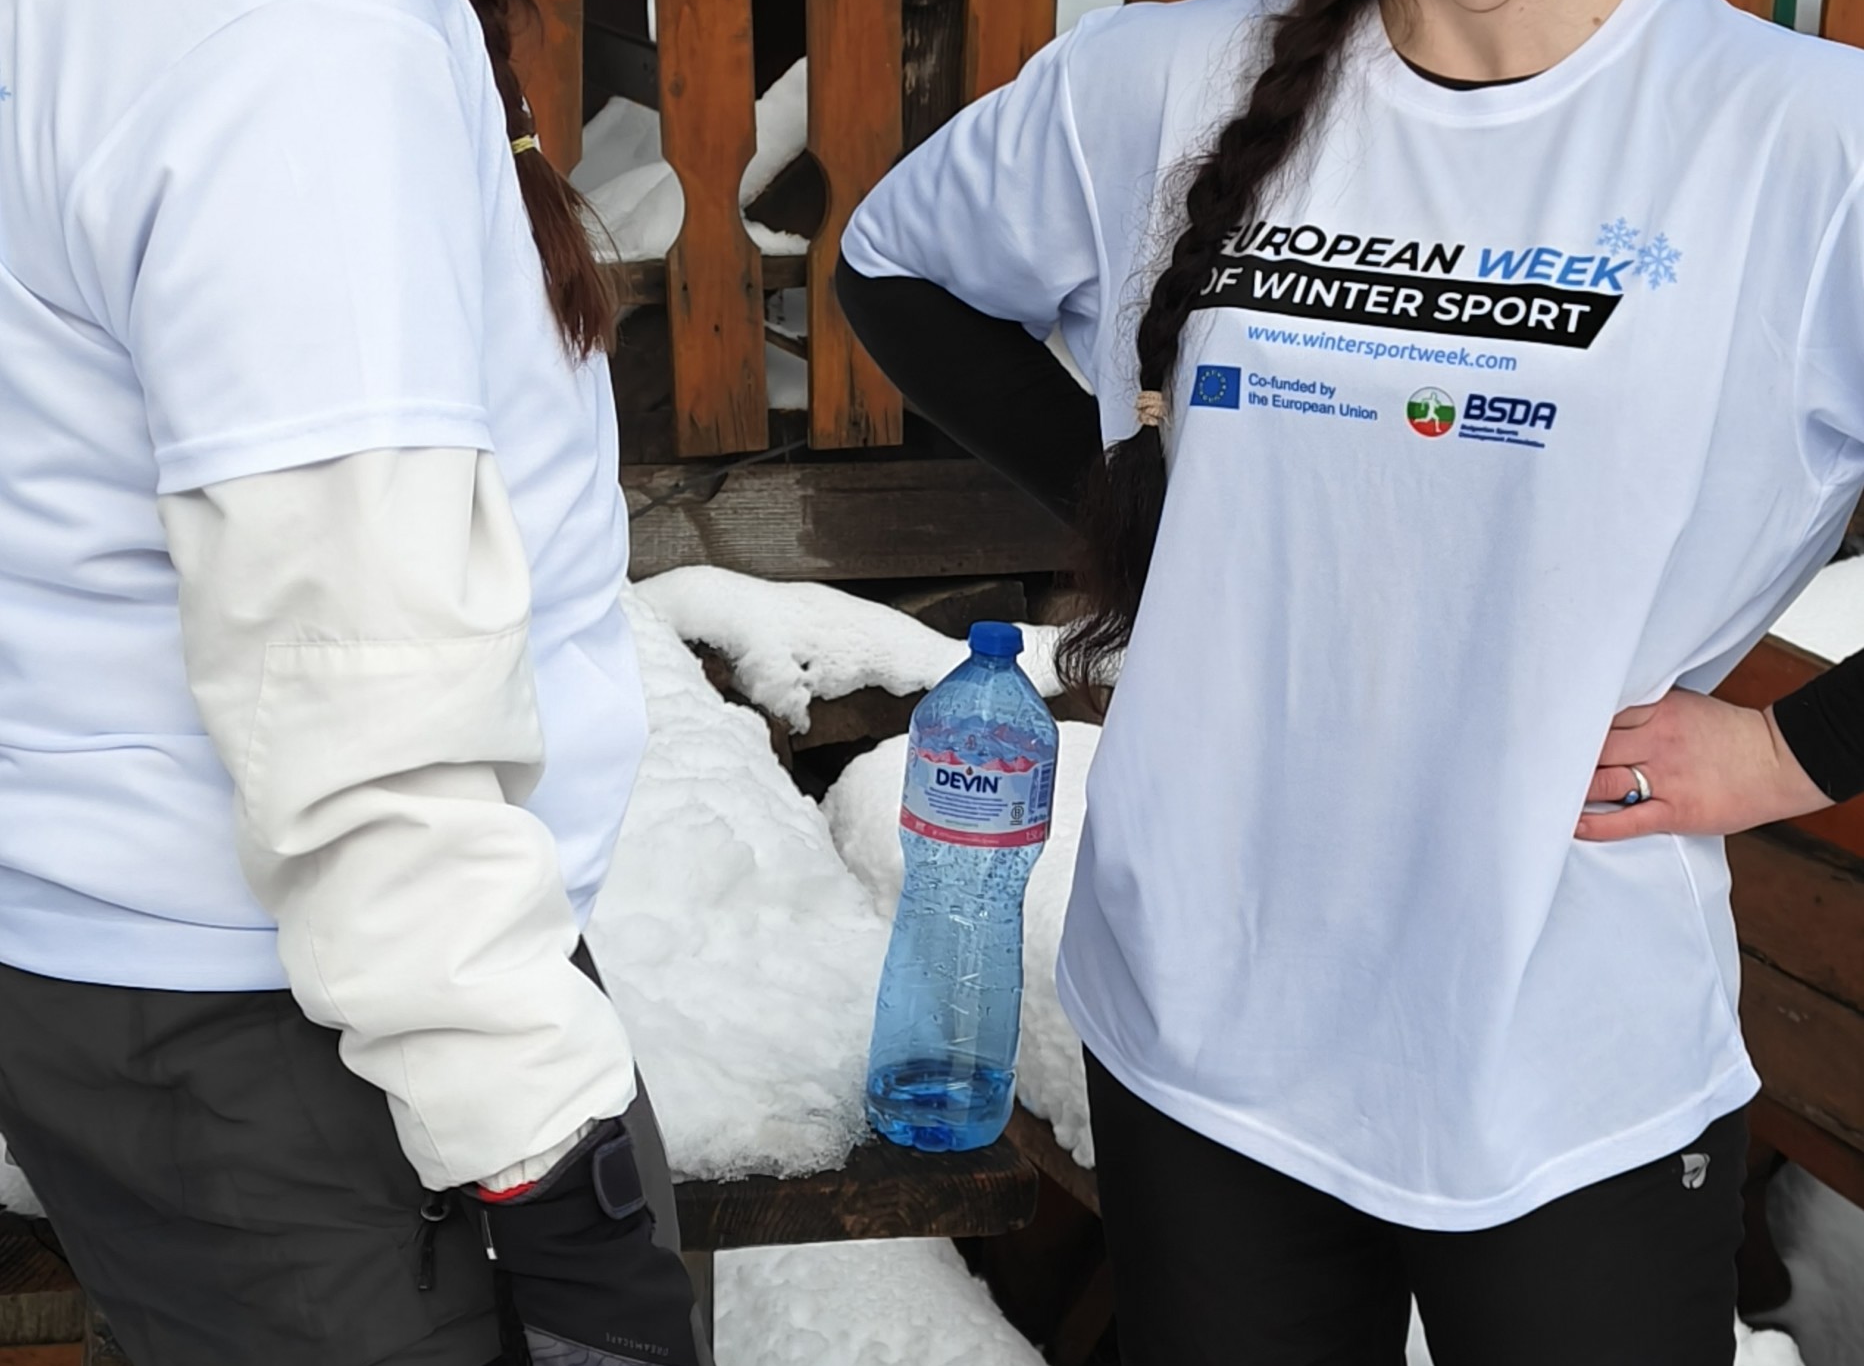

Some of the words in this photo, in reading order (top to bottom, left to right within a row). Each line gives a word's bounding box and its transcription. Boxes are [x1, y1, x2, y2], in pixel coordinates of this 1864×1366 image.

[1478, 247, 1633, 291] WEEK
[1253, 270, 1424, 317] WINTER
[1433, 292, 1591, 333] SPORT
[1248, 325, 1517, 371] www.wintersportweek.com
[1248, 373, 1316, 395] Co-funded
[1320, 381, 1336, 399] by
[1248, 392, 1269, 407] the
[1271, 395, 1336, 415] European
[1339, 403, 1378, 421] Union
[1463, 393, 1557, 430] BSDA
[936, 768, 999, 794] DEVIN
